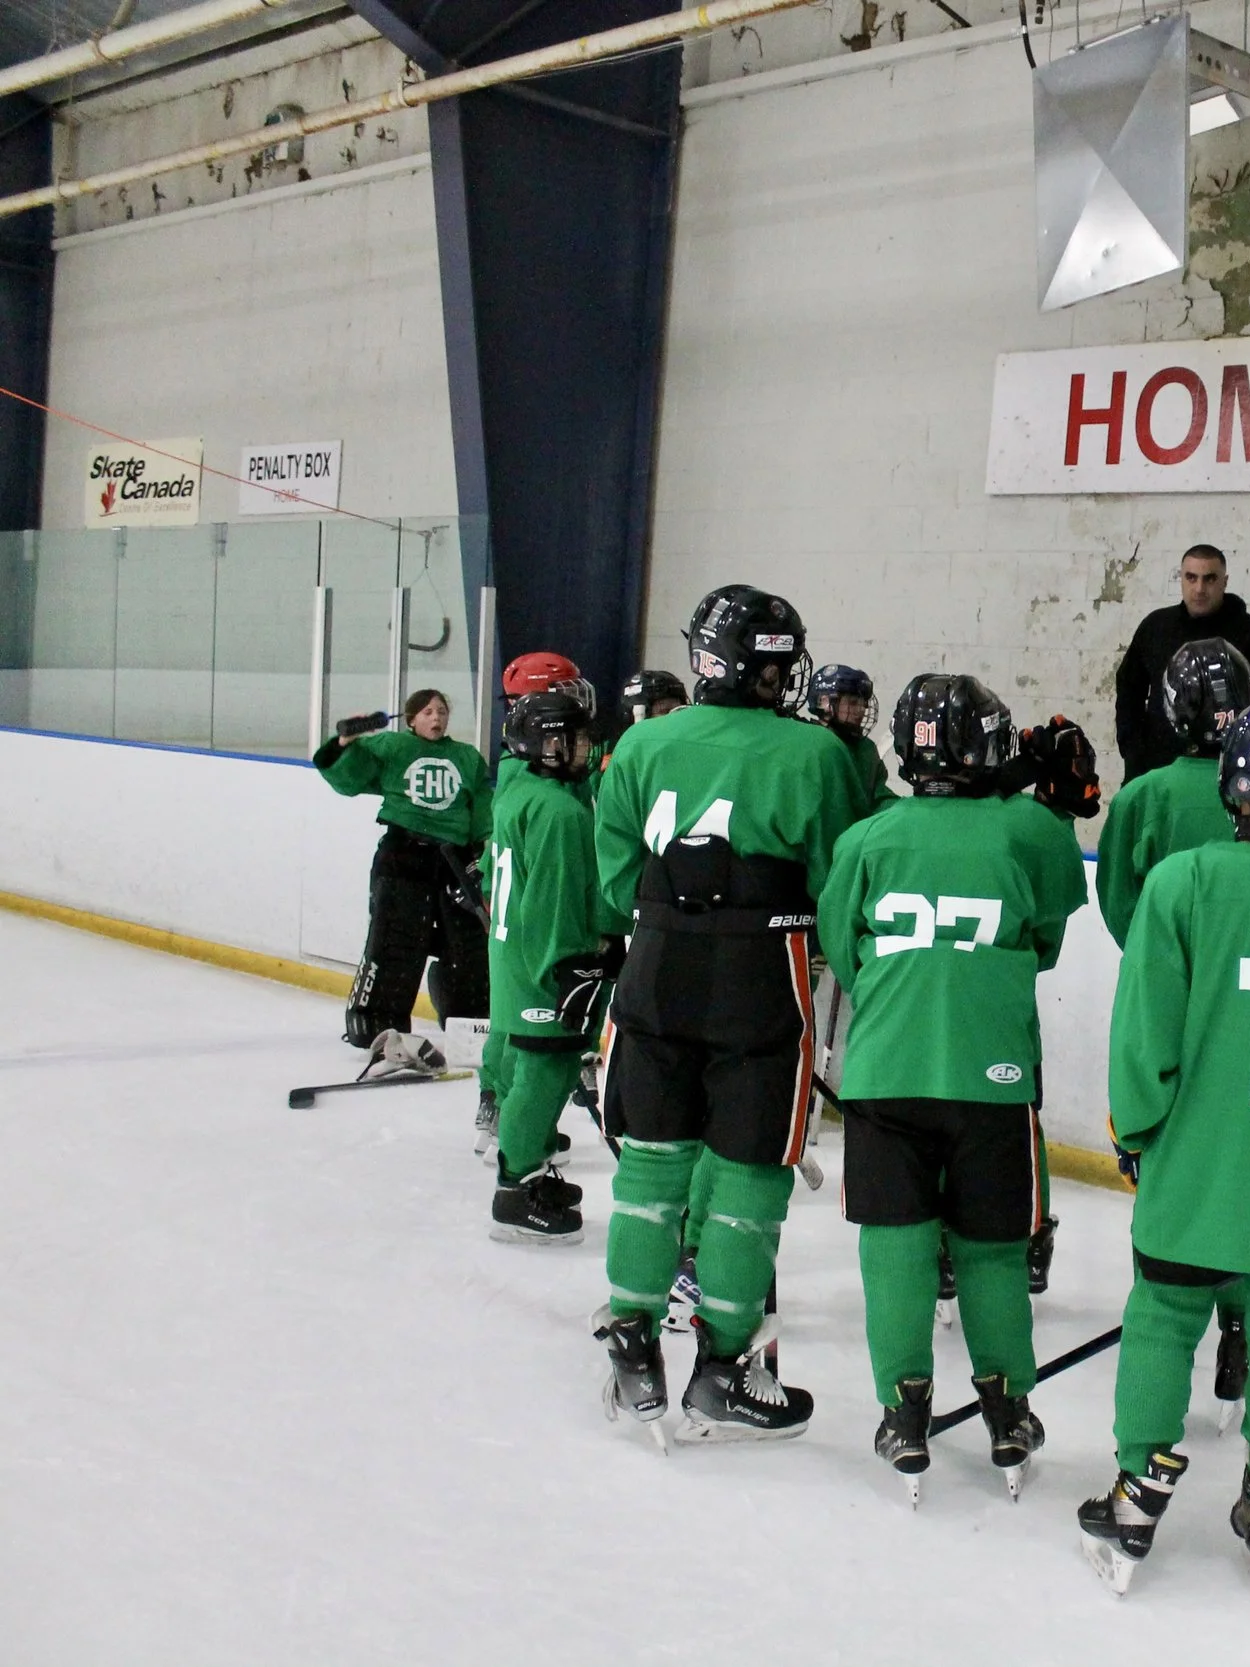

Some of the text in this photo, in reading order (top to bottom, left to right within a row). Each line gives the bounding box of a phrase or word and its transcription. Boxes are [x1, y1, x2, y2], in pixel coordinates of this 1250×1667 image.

[90, 455, 145, 480] Skate
[248, 451, 331, 481] PENALTY BOX
[121, 473, 195, 500] Canada
[699, 651, 716, 679] 15
[1214, 709, 1235, 730] 71
[914, 720, 937, 747] 91
[358, 961, 379, 1008] CCM
[473, 1024, 492, 1034] VAU
[527, 1214, 550, 1228] CCM
